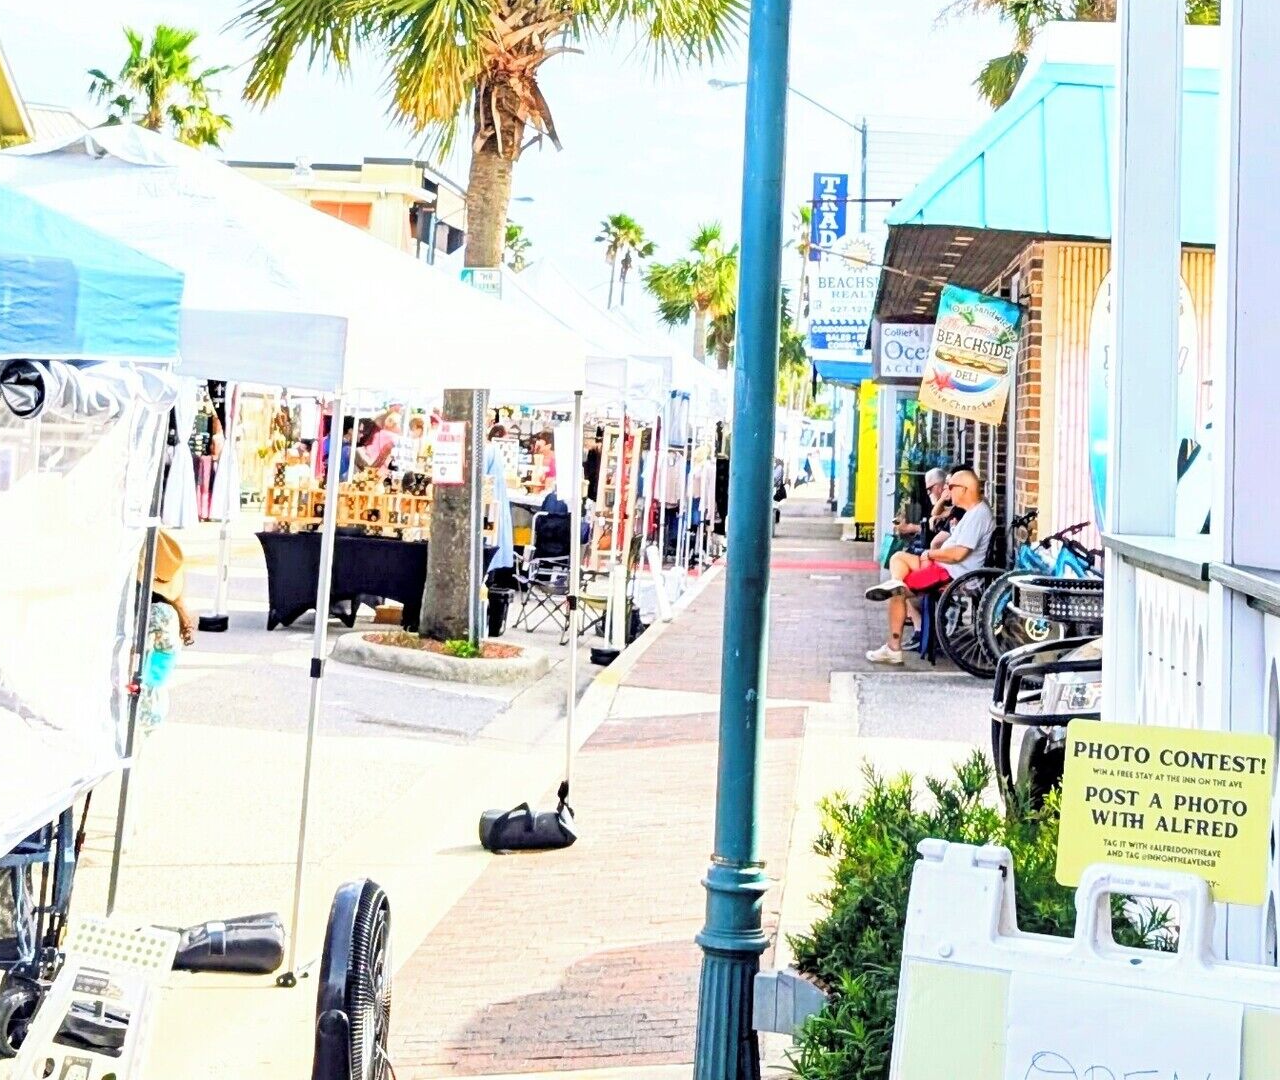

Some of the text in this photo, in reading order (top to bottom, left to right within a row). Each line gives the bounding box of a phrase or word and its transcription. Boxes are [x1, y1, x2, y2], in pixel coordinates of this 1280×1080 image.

[819, 176, 841, 261] TRAD
[936, 328, 1015, 360] BEACHSIDE
[949, 398, 996, 411] Character
[1073, 741, 1267, 775] PHOTO CONTEST!
[1092, 767, 1243, 789] WIN A FREE STAY AT THE INN ON THE AVE
[1085, 786, 1248, 817] POST A PHOTO
[1091, 808, 1239, 839] WITH ALFRED
[1103, 838, 1118, 849] TAG
[1119, 840, 1127, 849] IT
[1128, 841, 1148, 851] WITH
[1106, 849, 1123, 858] AND
[1125, 850, 1140, 860] TAG
